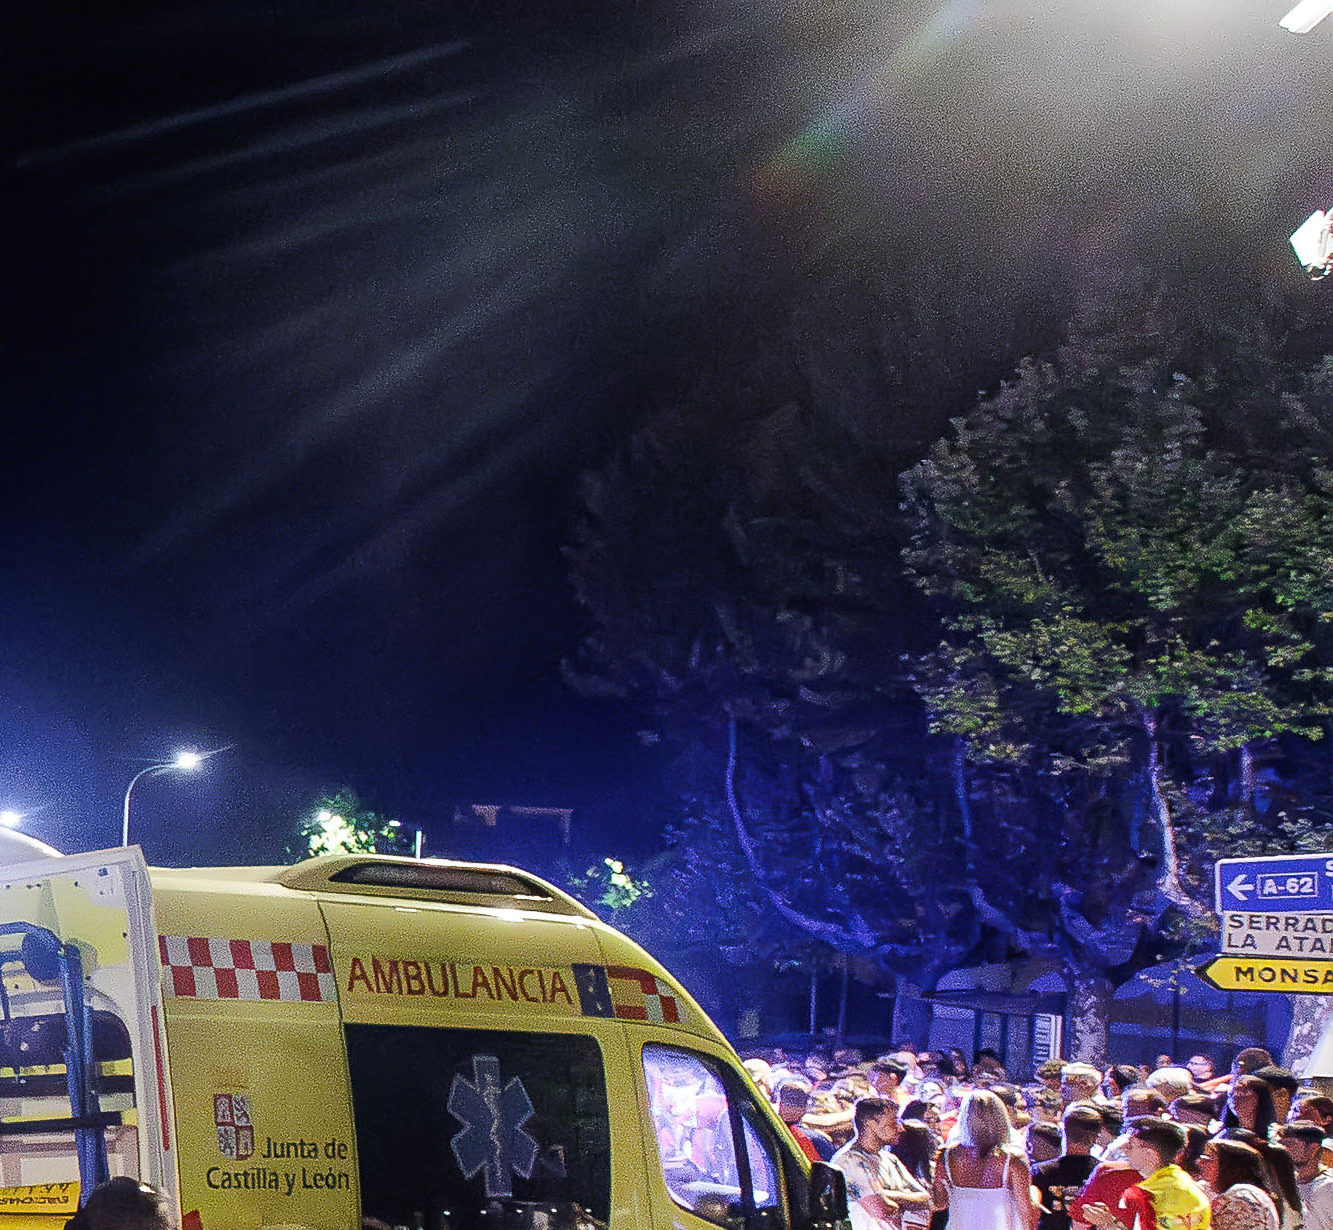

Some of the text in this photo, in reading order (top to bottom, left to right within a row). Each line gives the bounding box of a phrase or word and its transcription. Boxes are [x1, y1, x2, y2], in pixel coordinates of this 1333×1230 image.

[1262, 877, 1315, 895] A-62
[1227, 933, 1257, 950] LA
[347, 955, 573, 1005] AMBULANCIA
[262, 1137, 349, 1160] Junta de
[206, 1166, 351, 1196] Castilla y León
